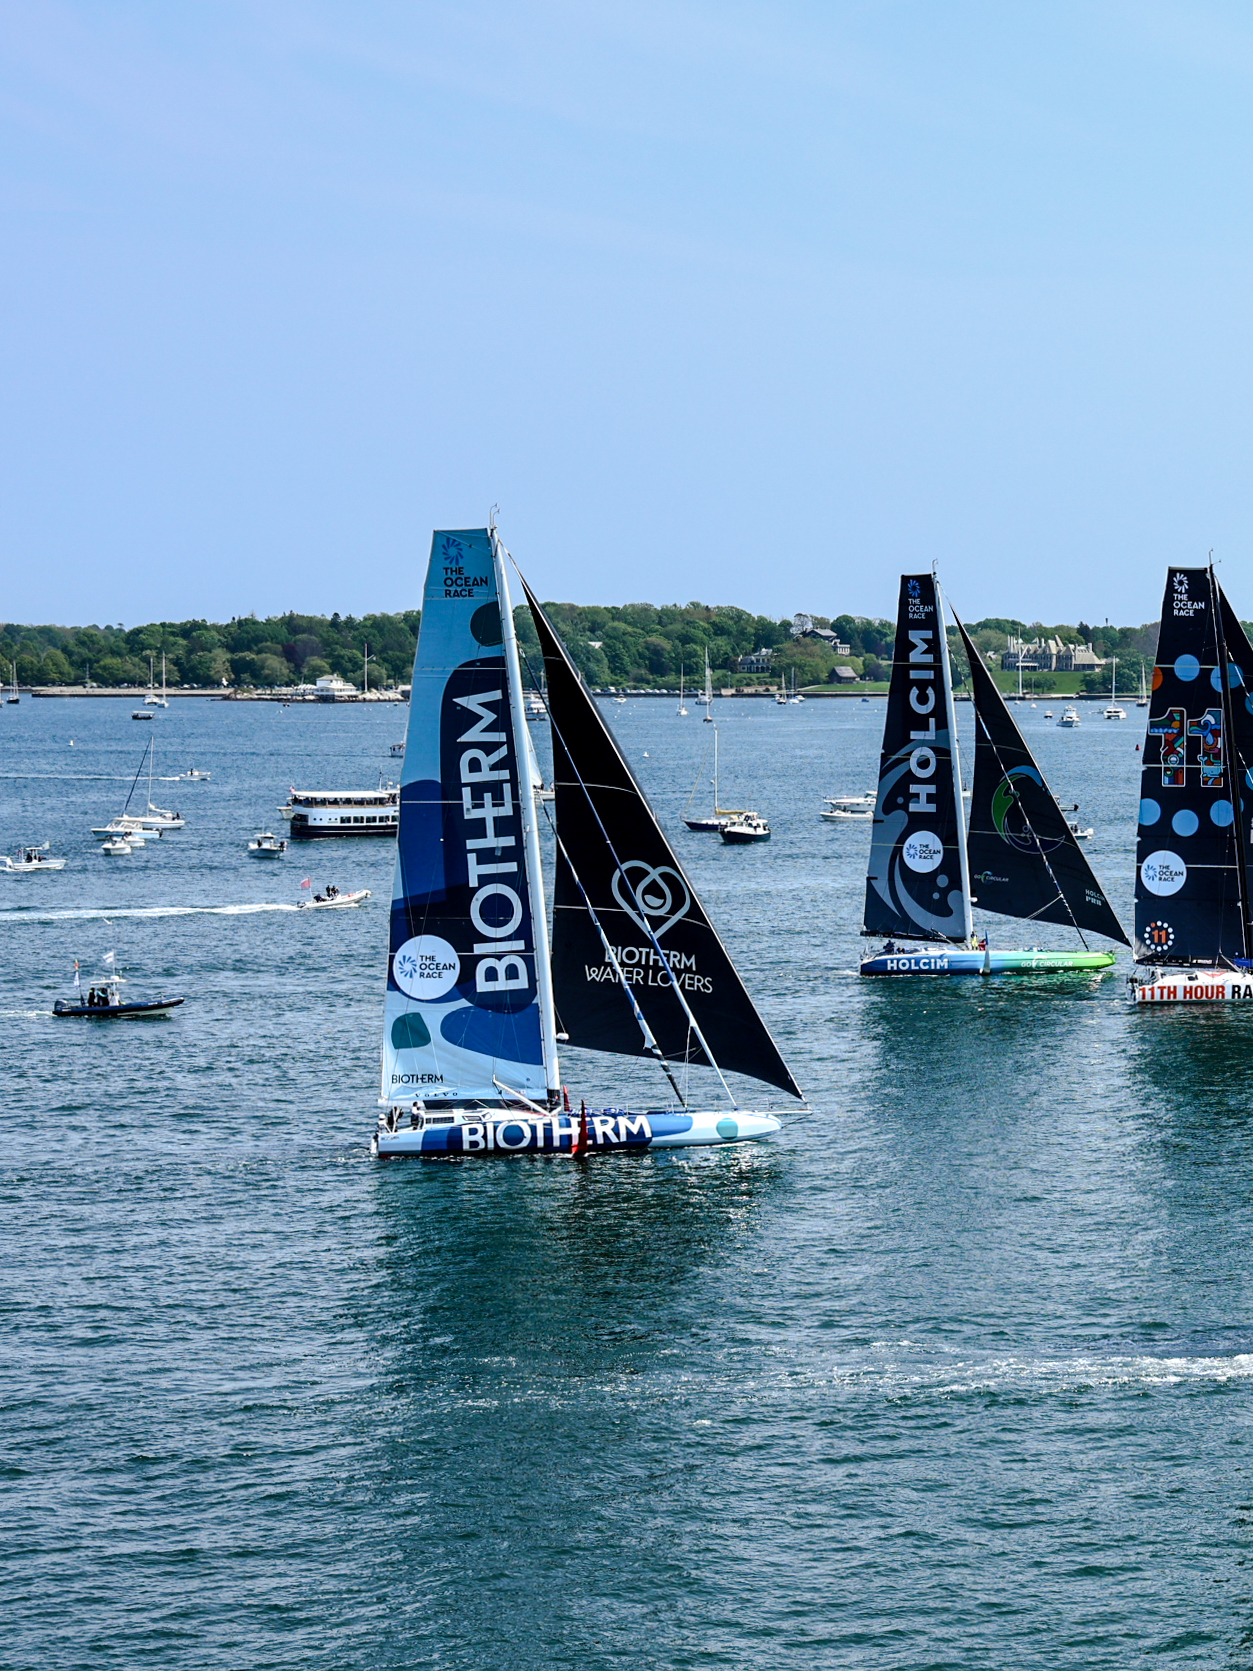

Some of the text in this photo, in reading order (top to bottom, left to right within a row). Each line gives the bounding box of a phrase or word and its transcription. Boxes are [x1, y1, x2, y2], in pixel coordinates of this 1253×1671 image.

[443, 567, 464, 576] THE
[443, 576, 488, 587] OCEAN
[444, 588, 474, 598] RACE
[1173, 601, 1205, 609] OCEAN
[908, 630, 936, 812] HOLCIM
[452, 689, 529, 993] BIOTHERM
[1152, 930, 1167, 943] 11
[419, 962, 456, 971] OCEAN
[887, 959, 948, 971] HOLCIM
[419, 971, 443, 979] RACE
[585, 964, 713, 994] WATER LOVERS
[1140, 985, 1178, 1000] 11TH
[1183, 985, 1226, 1000] HOUR
[391, 1074, 444, 1084] BIOTHERM
